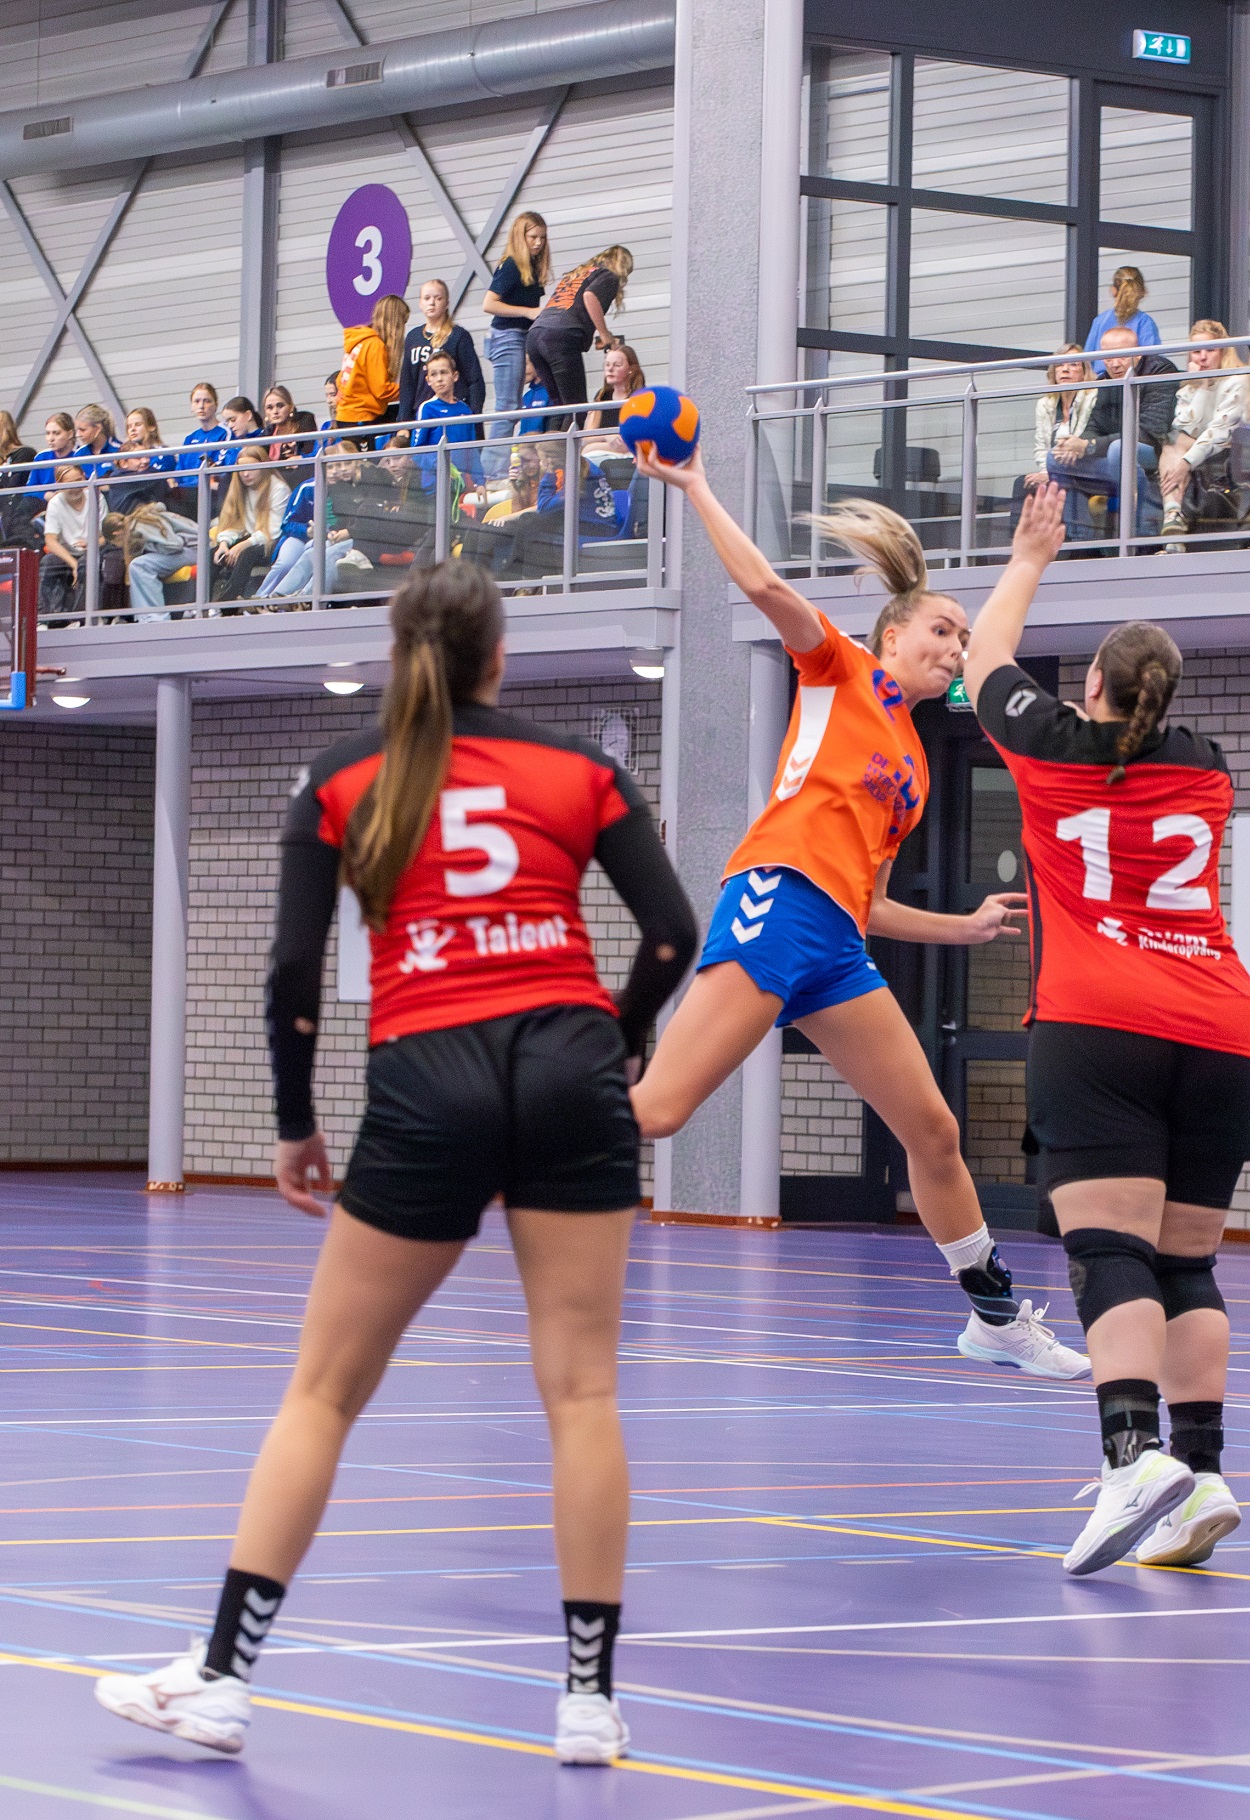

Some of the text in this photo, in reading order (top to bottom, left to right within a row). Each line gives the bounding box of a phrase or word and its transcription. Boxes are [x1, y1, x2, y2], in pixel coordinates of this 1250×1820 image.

[352, 225, 383, 296] 3
[410, 346, 443, 365] US
[439, 785, 520, 897] 5
[1056, 806, 1214, 911] 12
[465, 911, 571, 957] Talent
